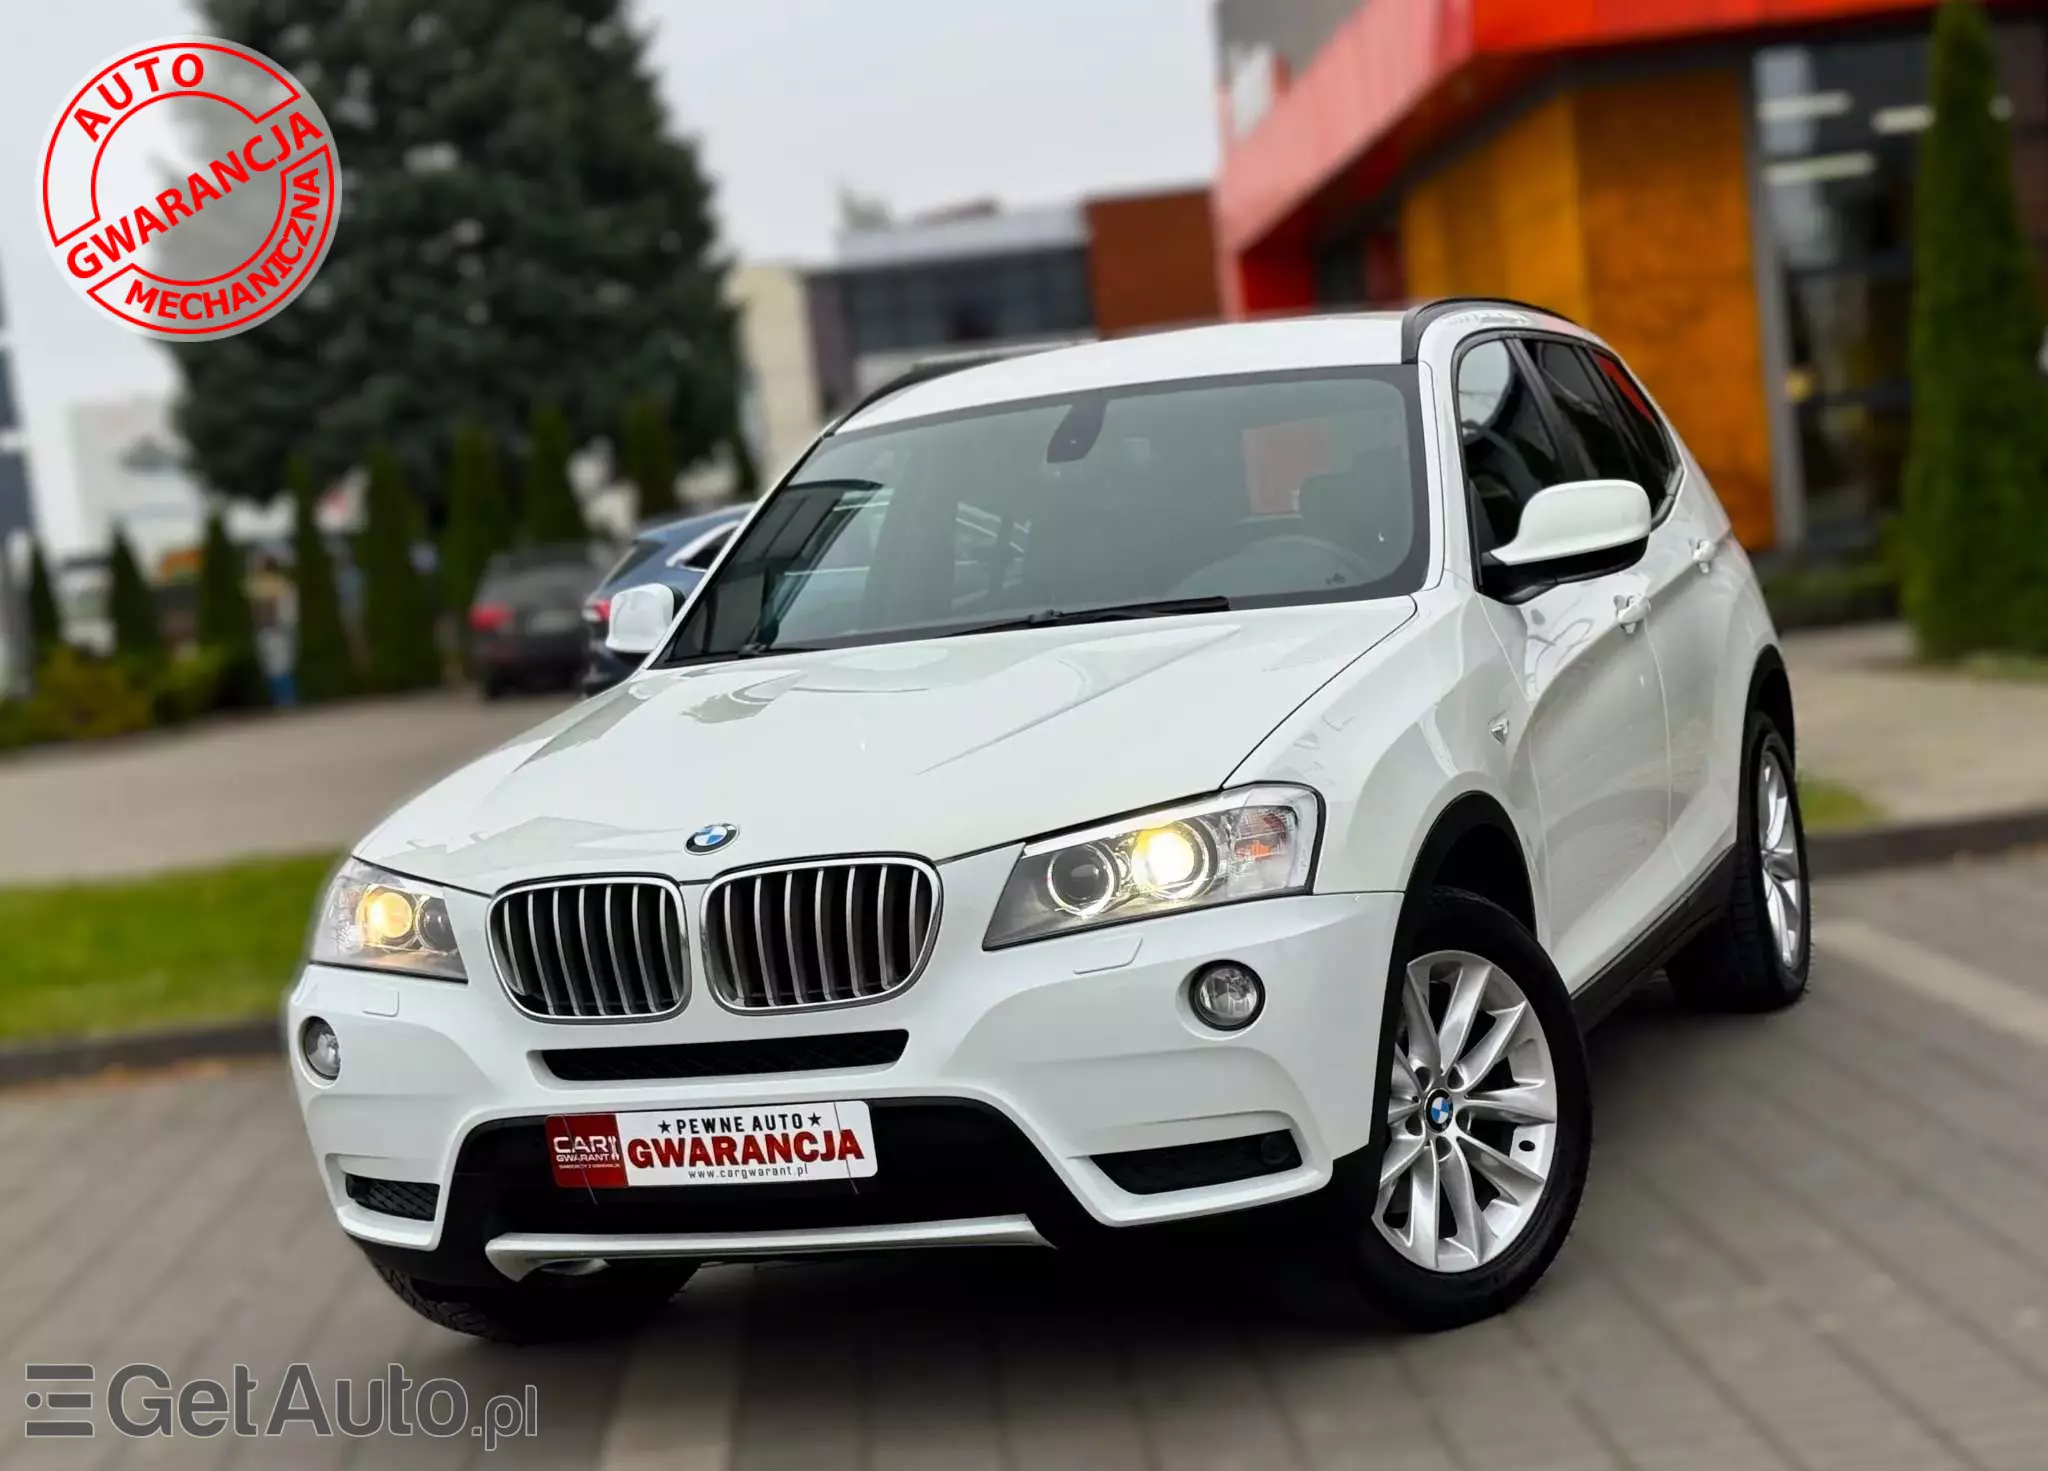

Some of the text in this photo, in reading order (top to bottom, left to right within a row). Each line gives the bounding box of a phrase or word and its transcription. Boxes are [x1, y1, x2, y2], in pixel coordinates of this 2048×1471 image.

[676, 1112, 803, 1135] PEWNE AUTO
[553, 1135, 609, 1153] CAR
[627, 1128, 865, 1169] GWARANCJA
[556, 1153, 609, 1162] GWARANT
[688, 1163, 809, 1180] www.cargwarant.pl
